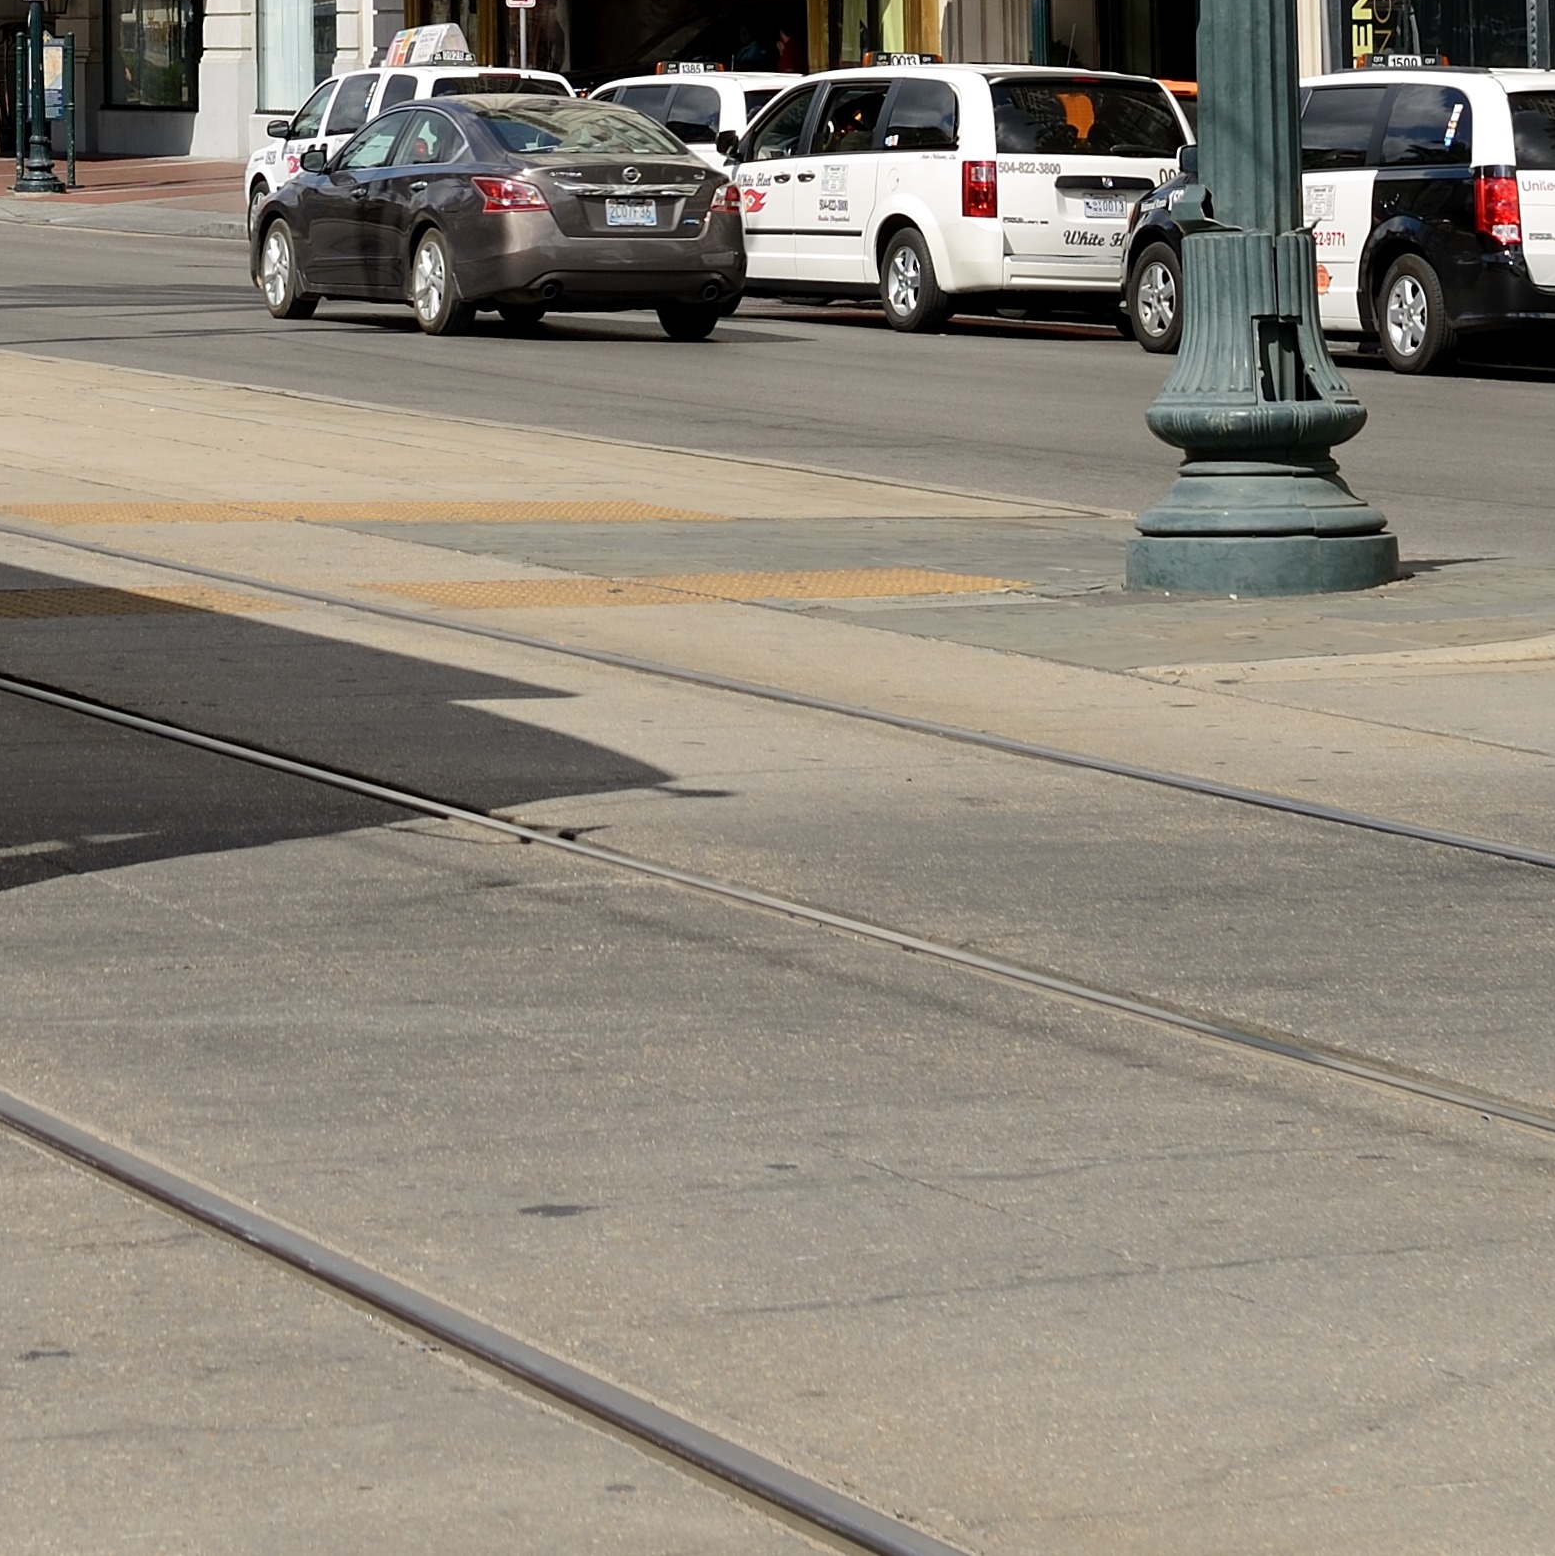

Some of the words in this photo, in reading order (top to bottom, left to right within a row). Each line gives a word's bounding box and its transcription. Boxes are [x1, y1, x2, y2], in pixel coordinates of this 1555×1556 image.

[998, 161, 1061, 175] 504-822-3800
[1103, 200, 1124, 213] 0013
[1063, 230, 1106, 247] White
